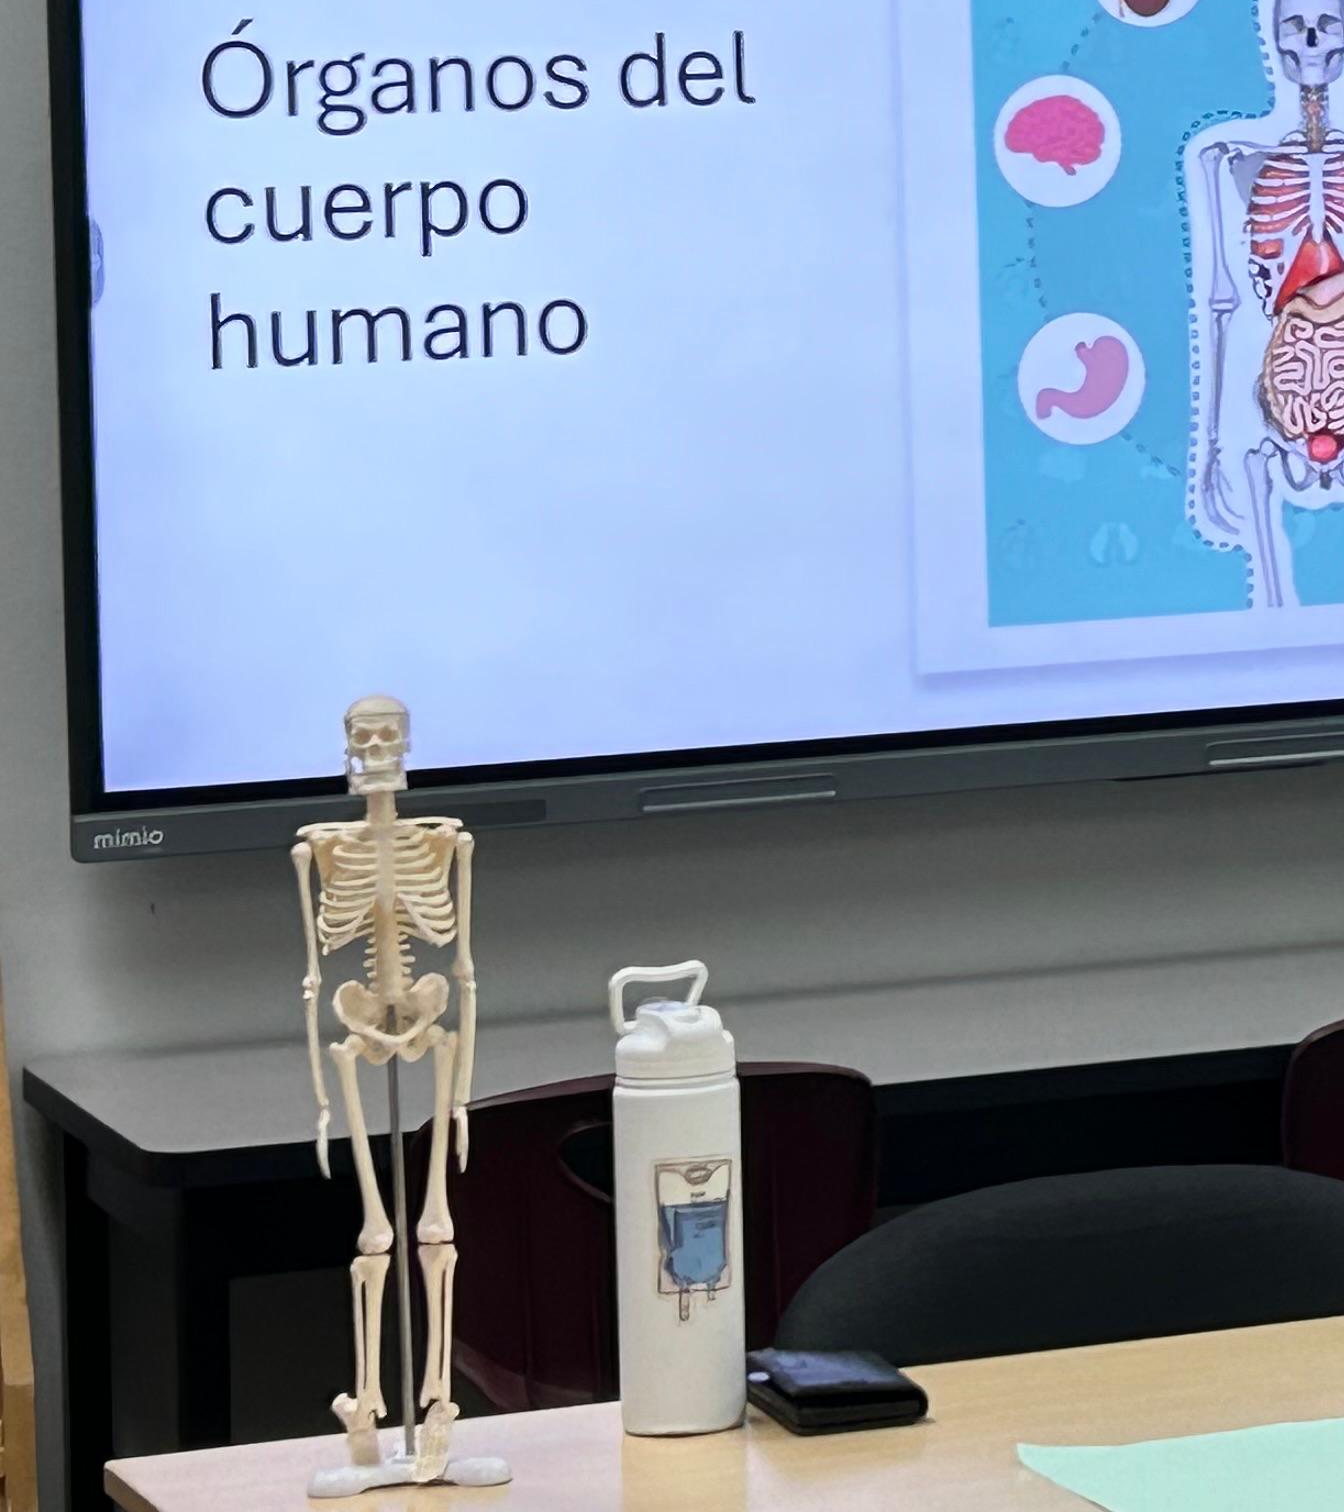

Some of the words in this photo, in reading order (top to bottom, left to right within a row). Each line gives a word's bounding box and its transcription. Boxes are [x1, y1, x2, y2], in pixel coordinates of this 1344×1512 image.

[202, 18, 590, 136] Órganos
[618, 30, 756, 109] del
[205, 178, 529, 257] cuerpo
[209, 292, 588, 370] humano
[93, 825, 164, 849] mimio
